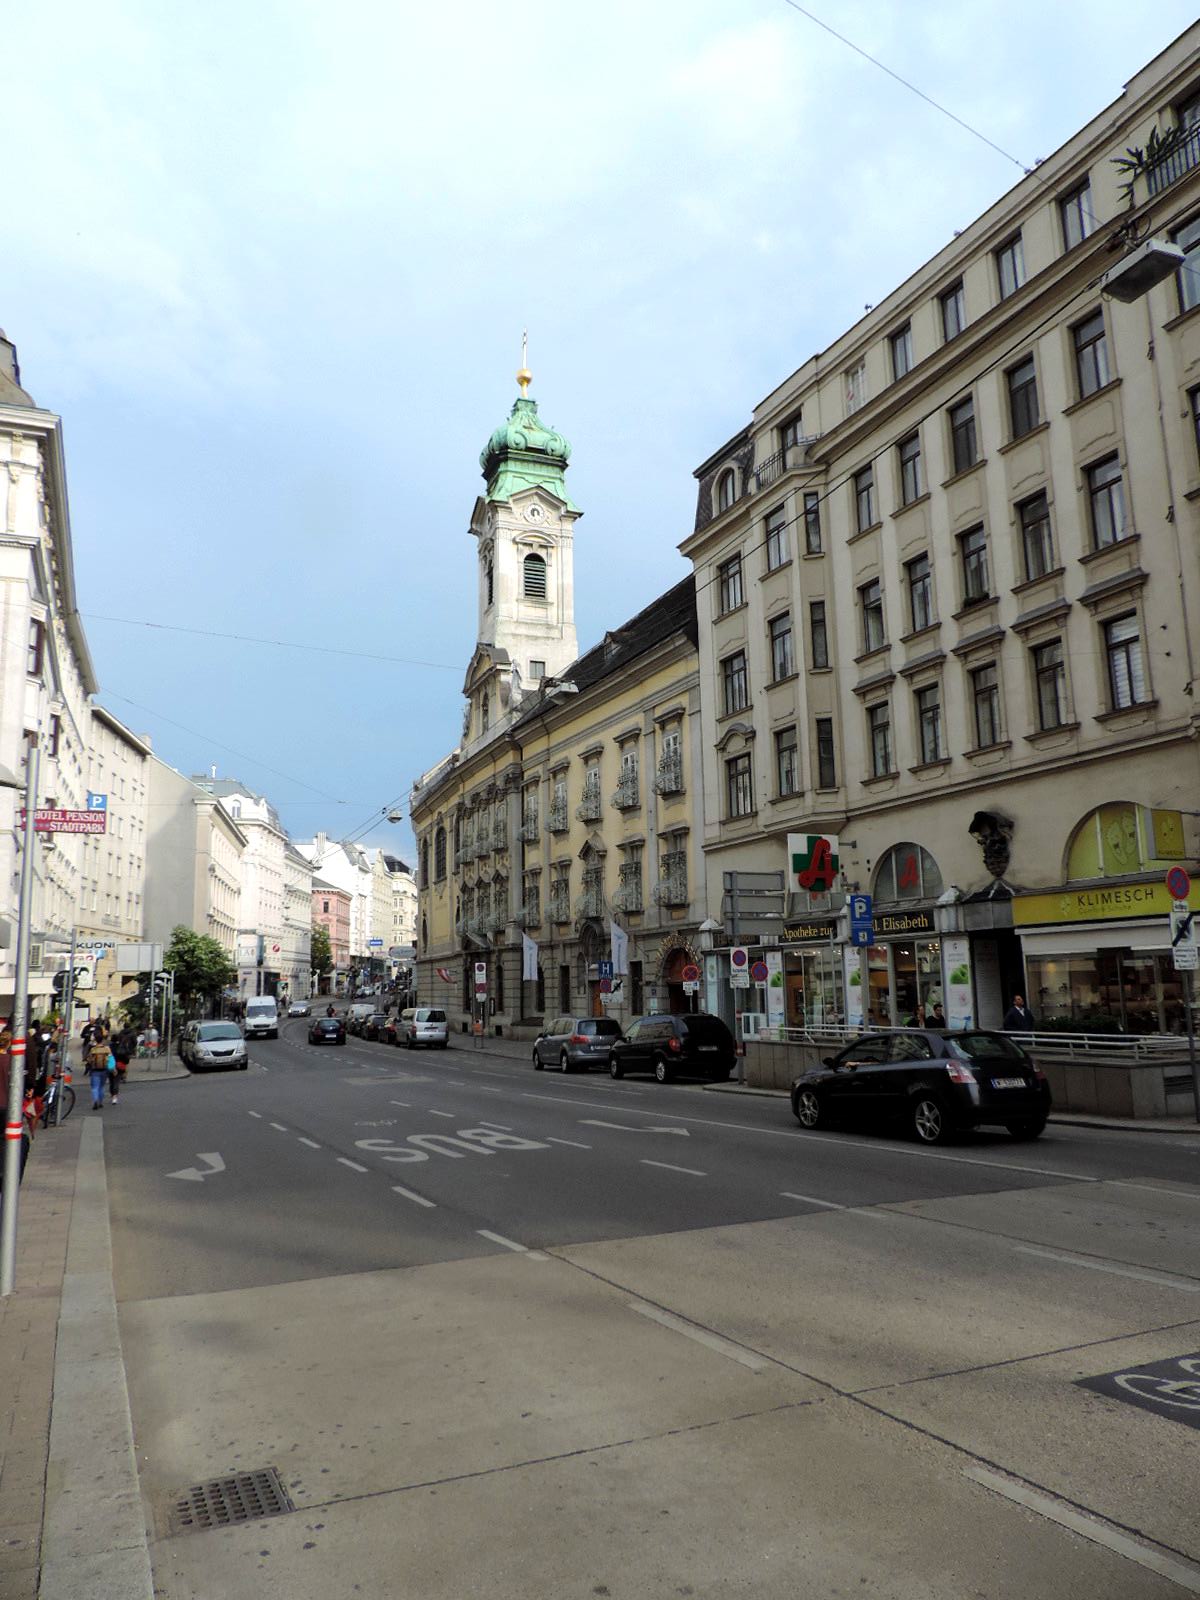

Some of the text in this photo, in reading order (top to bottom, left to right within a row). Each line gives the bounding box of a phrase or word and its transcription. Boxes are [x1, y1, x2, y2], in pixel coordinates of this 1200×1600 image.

[92, 795, 103, 807] P
[34, 810, 104, 822] HOTEL PENSION
[49, 821, 105, 833] STADTPARK
[798, 838, 837, 889] A
[1077, 887, 1155, 907] KLIMESCH
[855, 902, 867, 918] P
[883, 913, 929, 931] Elisabeth
[783, 925, 817, 942] Apotheke
[76, 942, 116, 950] KUONI
[602, 963, 610, 973] H
[355, 1128, 552, 1163] BUS
